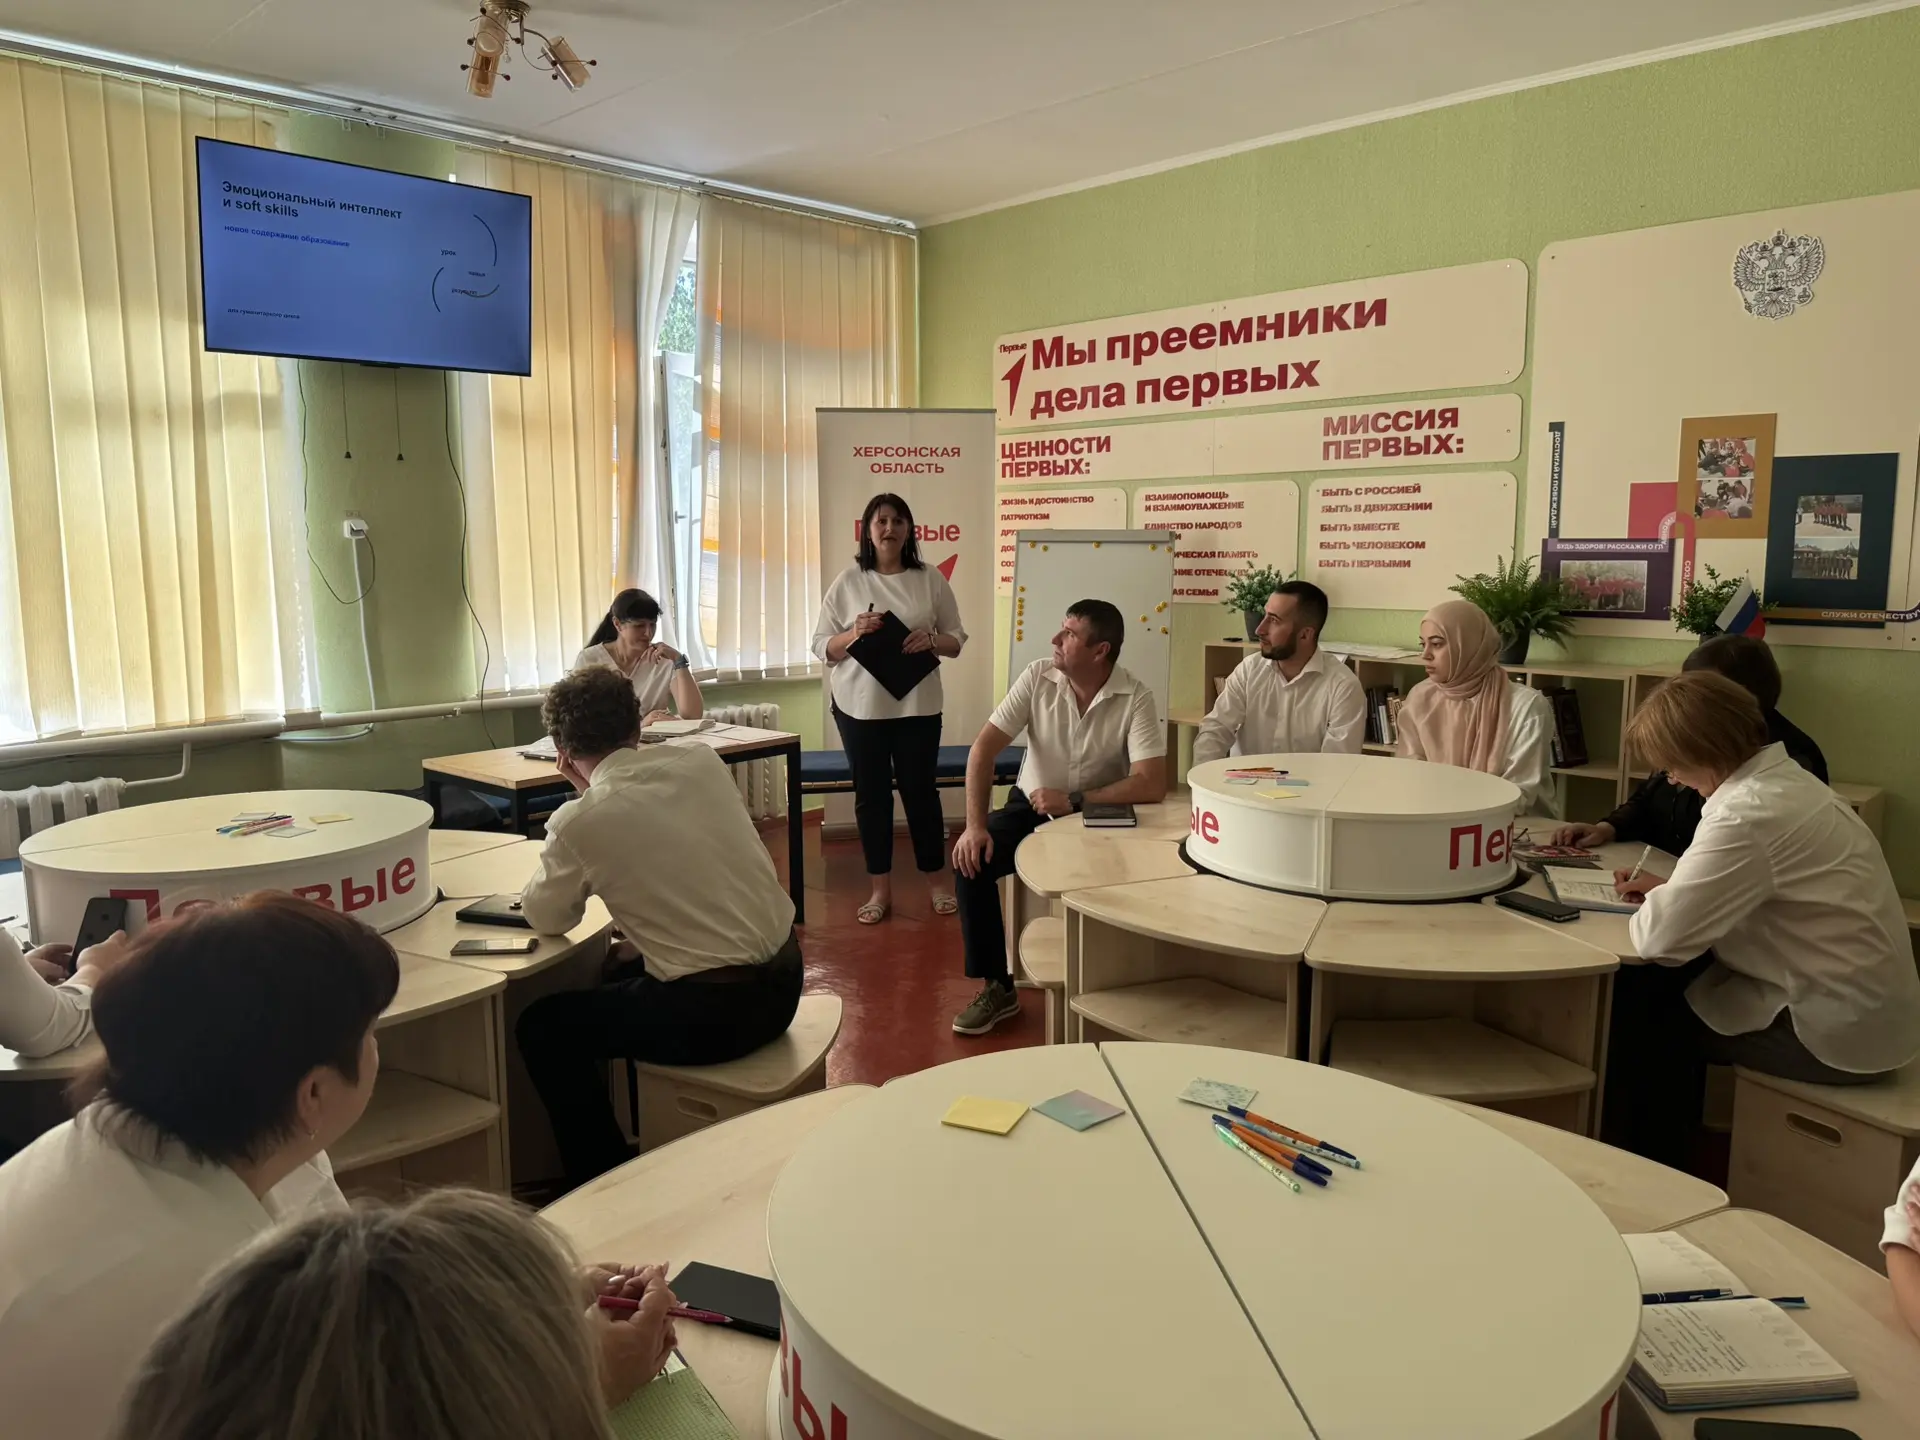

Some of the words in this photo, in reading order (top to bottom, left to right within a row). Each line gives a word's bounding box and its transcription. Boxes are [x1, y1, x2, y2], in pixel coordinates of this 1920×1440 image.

[222, 181, 336, 209] Эмоциональный
[339, 201, 402, 219] интеллект
[223, 198, 232, 207] и
[235, 199, 261, 212] soft
[264, 203, 299, 218] skills
[224, 225, 249, 234] новое
[251, 227, 299, 241] содержание
[1032, 335, 1096, 370] Мы
[1106, 298, 1387, 366] преемники
[1000, 343, 1027, 354] Первые
[1030, 381, 1126, 420] дела
[1136, 359, 1321, 407] первых
[1323, 407, 1459, 436] МИССИЯ
[853, 446, 961, 457] ХЕРСОНСКАЯ
[1001, 435, 1111, 461] ЦЕННОСТИ
[1322, 433, 1464, 460] ПЕРВЫХ:
[1553, 431, 1561, 473] ДОСТИГАЙ
[870, 463, 945, 473] ОБЛАСТЬ
[1001, 458, 1090, 478] ПЕРВЫХ:
[1321, 488, 1353, 497] БЫТЬ
[1354, 487, 1363, 496] С
[1364, 483, 1421, 496] РОССИЕЙ
[1034, 496, 1094, 506] ДОСТОИНСТВО
[1144, 491, 1229, 501] ВЗАИМОПОМОЩЬ
[1144, 504, 1151, 512] И
[1152, 501, 1245, 511] ВЗАИМОУВАЖЕНИЕ
[1321, 504, 1352, 513] БЫТЬ
[1354, 504, 1361, 512] В
[1363, 502, 1433, 514] ДВИЖЕНИИ
[1001, 513, 1050, 521] ПАТРИОТИЗМ
[1144, 522, 1193, 530] ЕДИНСТВО
[1195, 521, 1242, 530] НАРОДОВ
[1320, 523, 1351, 532] БЫТЬ
[1352, 522, 1400, 532] ВМЕСТЕ
[1319, 541, 1350, 549] БЫТЬ
[1352, 541, 1426, 549] ЧЕЛОВЕКОМ
[1217, 550, 1259, 558] ПАМЯТЬ
[1318, 560, 1350, 568] БЫТЬ
[1351, 559, 1411, 568] ПЕРВЫМИ
[1186, 588, 1219, 596] СЕМЬЯ
